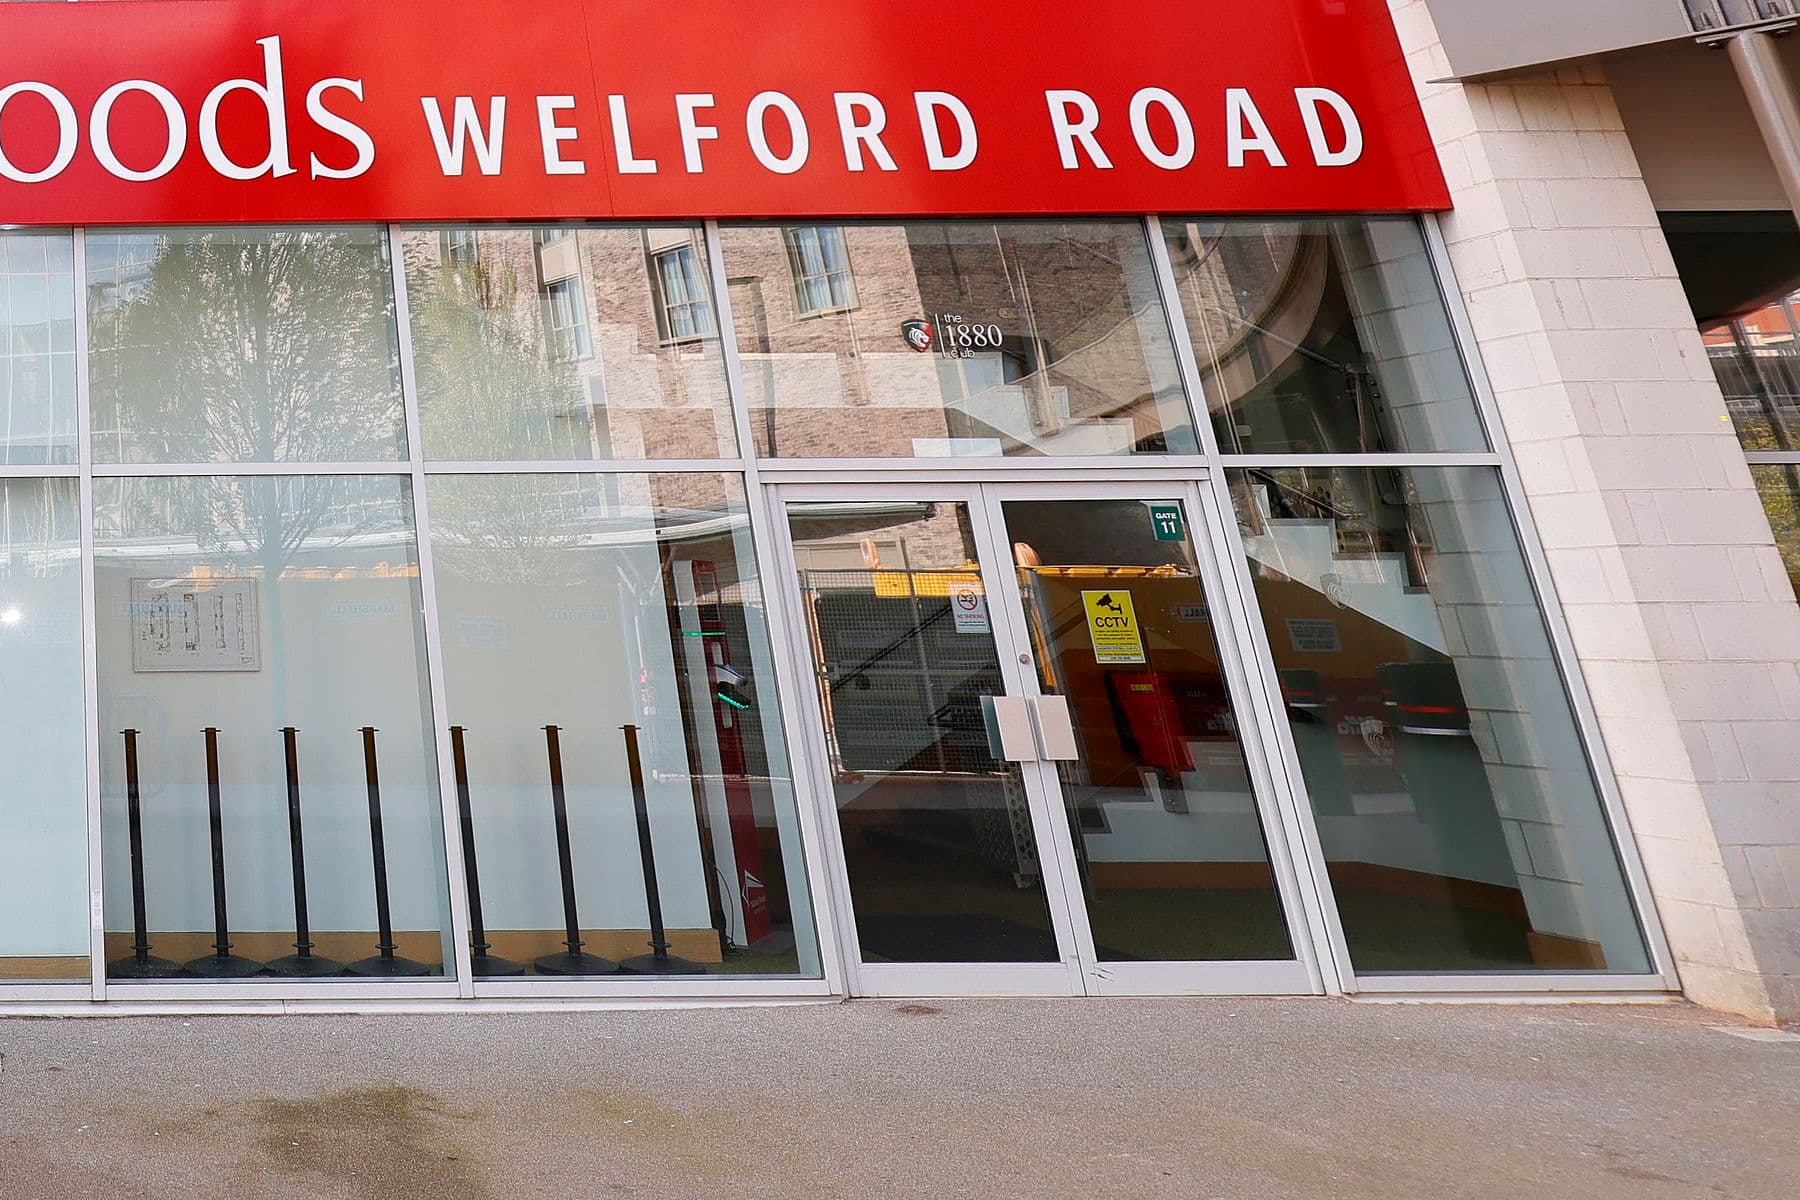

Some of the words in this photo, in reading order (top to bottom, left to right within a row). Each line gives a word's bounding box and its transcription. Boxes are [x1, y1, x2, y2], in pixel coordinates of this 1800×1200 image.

[419, 88, 978, 177] WELFORD
[1045, 86, 1366, 170] ROAD
[944, 313, 962, 323] the
[946, 324, 1003, 347] 1880
[1161, 521, 1176, 534] 11
[1095, 617, 1128, 628] CCTV
